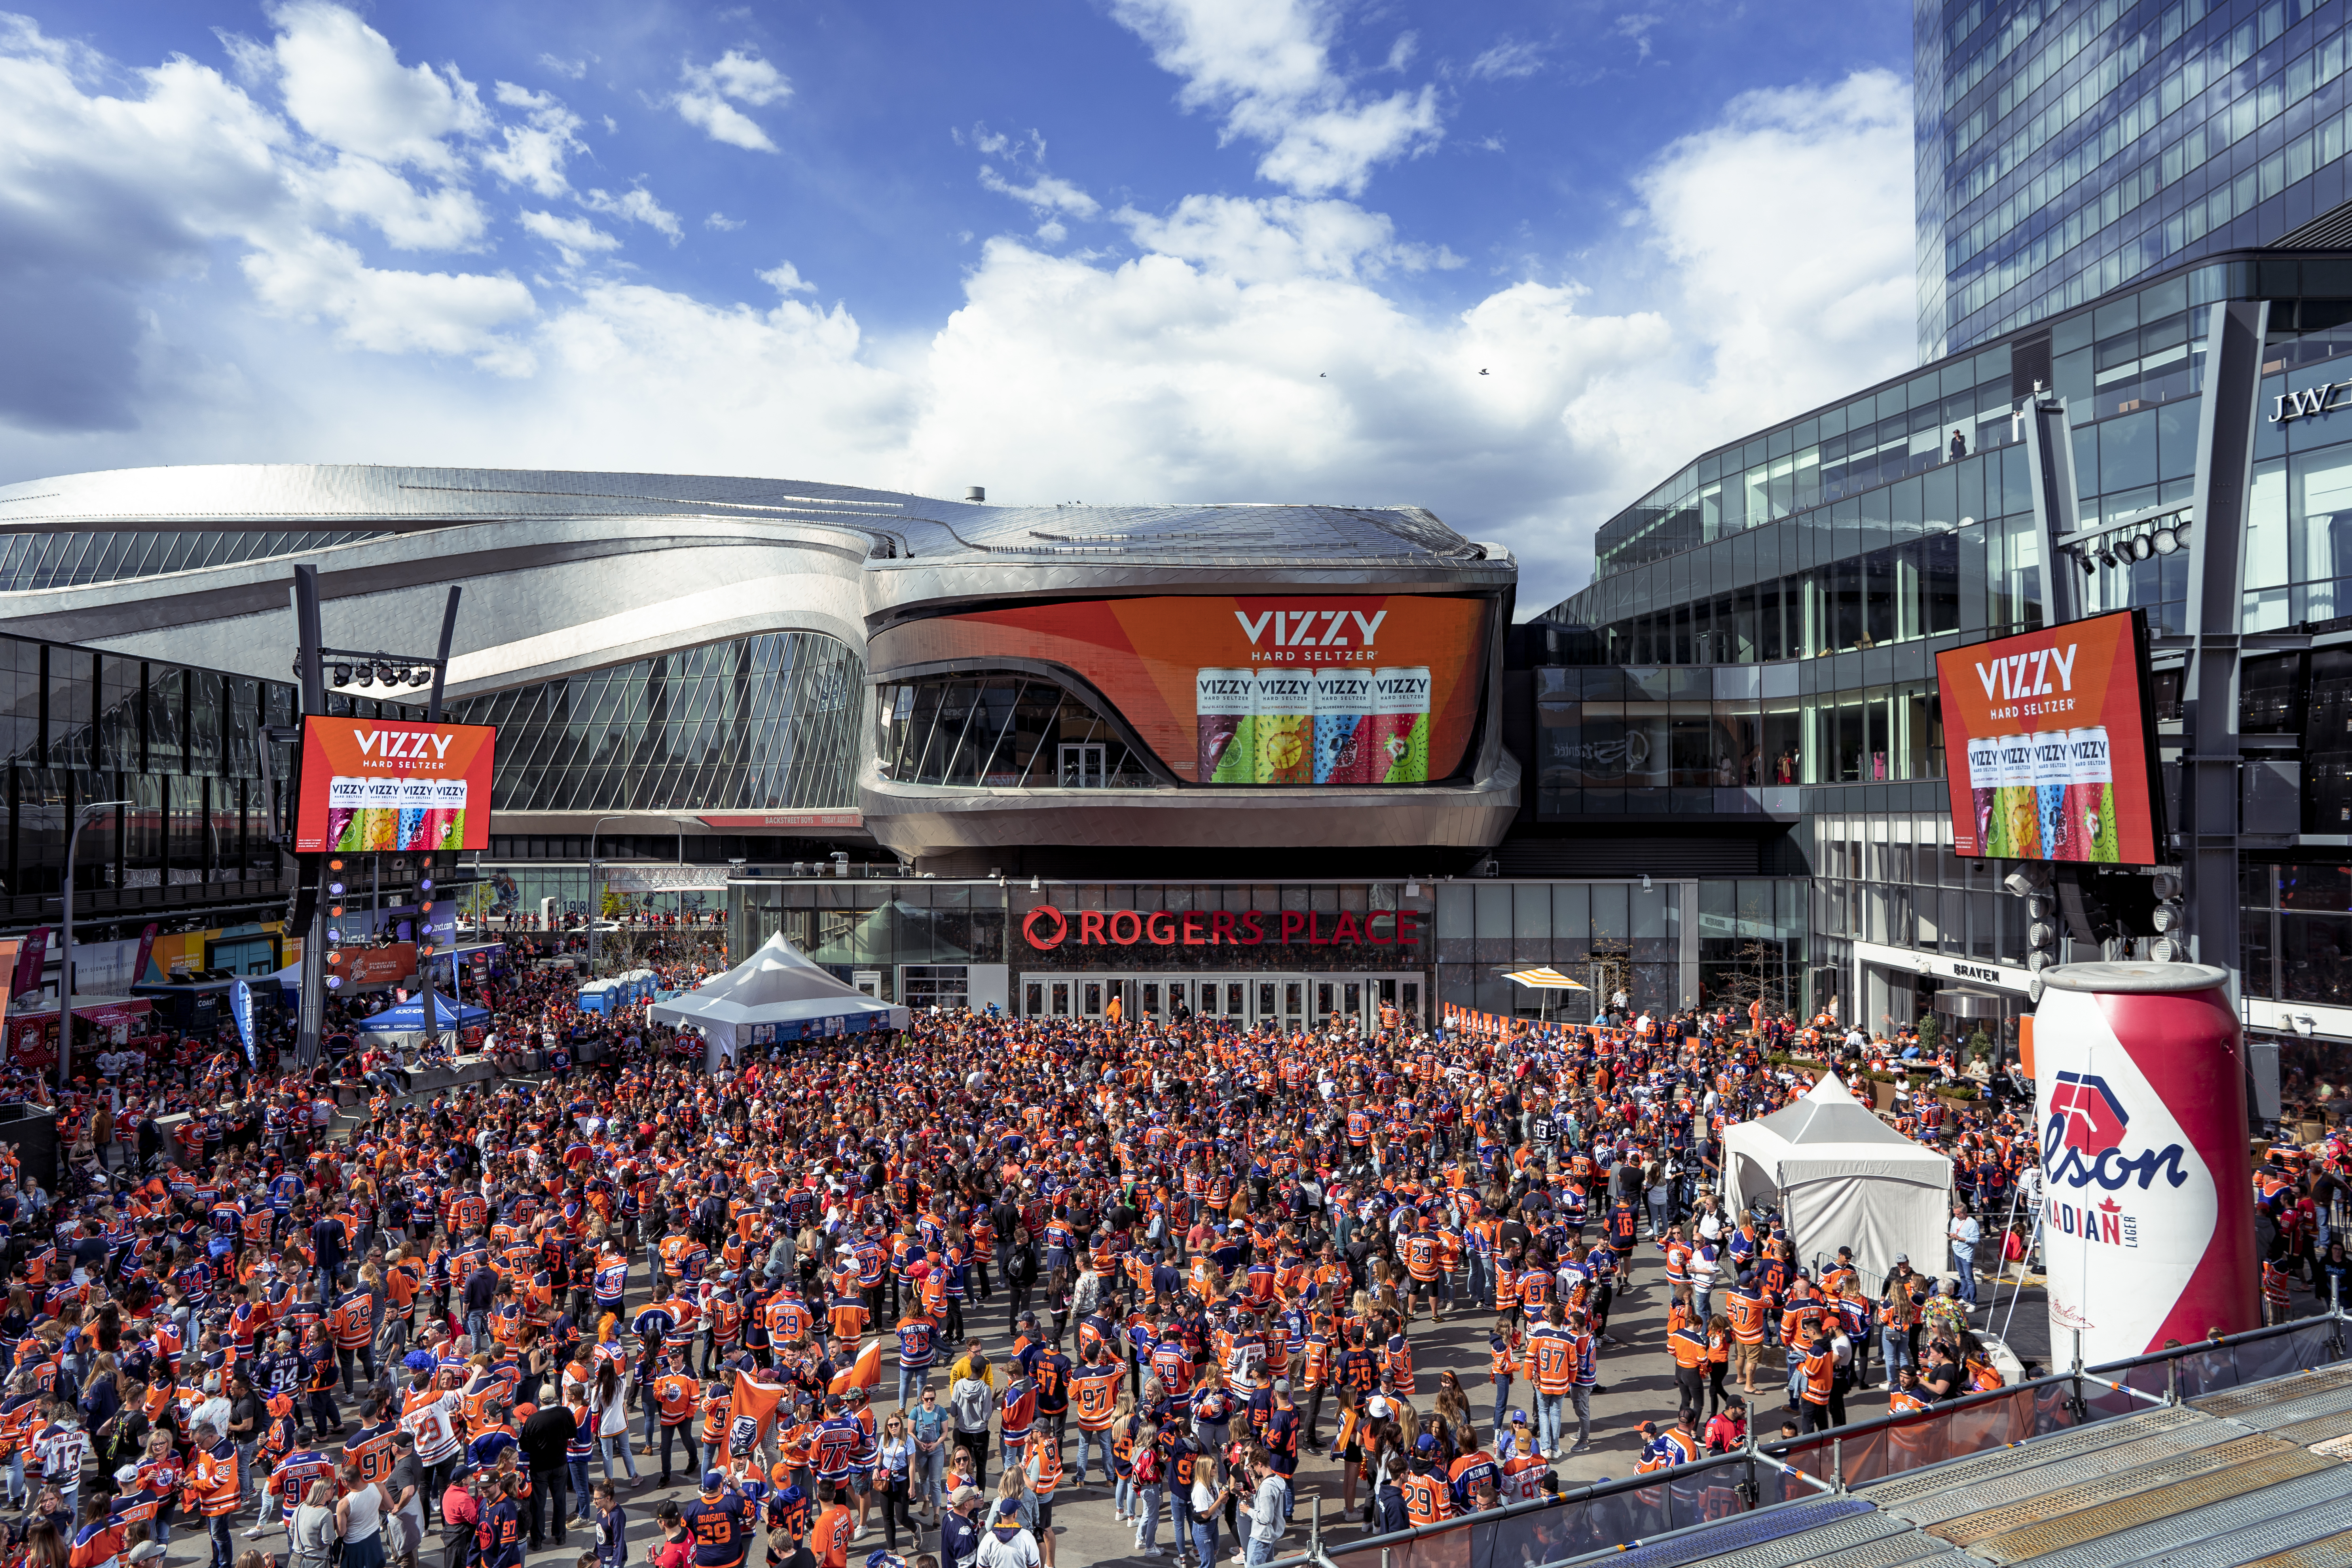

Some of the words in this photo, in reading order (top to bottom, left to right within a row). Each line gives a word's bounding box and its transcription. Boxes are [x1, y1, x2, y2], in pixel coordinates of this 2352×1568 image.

[2269, 383, 2332, 422] JW
[1234, 611, 1387, 646] VIZZY
[1252, 652, 1295, 660] HARD
[1305, 651, 1374, 660] SELTZER
[1975, 644, 2077, 701] VIZZY
[1200, 680, 1251, 694] VIZZY
[1259, 680, 1311, 694] VIZZY
[1318, 680, 1369, 694] VIZZY
[1377, 679, 1427, 693] VIZZY
[1991, 706, 2018, 720] HARD
[2024, 698, 2074, 716] SELTZER
[354, 730, 453, 758] VIZZY
[2071, 741, 2106, 759] VIZZY
[1970, 751, 1997, 766] VIZZY
[2001, 748, 2030, 764] VIZZY
[2034, 745, 2066, 761] VIZZY
[333, 785, 364, 794] VIZZY
[369, 786, 399, 794] VIZZY
[404, 786, 432, 795] VIZZY
[437, 787, 465, 796] VIZZY
[822, 816, 836, 825] FRIDAY,
[563, 900, 589, 914] 198
[1081, 910, 1263, 945] ROGERS
[1282, 910, 1419, 945] PLACE
[283, 943, 302, 952] SUCCES
[90, 963, 119, 972] SIGNATURE
[172, 959, 199, 967] SUCCESS
[26, 956, 36, 987] LEMONADE
[1954, 964, 1999, 983] BRAVEN
[198, 998, 216, 1007] COAST
[2042, 1112, 2188, 1190] lson
[279, 1182, 296, 1197] 14
[791, 1202, 811, 1219] 99
[1618, 1218, 1633, 1236] 18
[2045, 1197, 2120, 1245] NADIAN
[2124, 1216, 2138, 1248] LAGER
[1564, 1271, 1580, 1280] EBERLE
[1772, 1264, 1783, 1272] KANE
[180, 1271, 203, 1292] 94
[1766, 1270, 1784, 1294] 91
[346, 1299, 367, 1310] DRAISAITL
[347, 1306, 370, 1332] 29
[1731, 1304, 1749, 1325] 97
[566, 1326, 578, 1337] 18
[776, 1315, 799, 1335] 29
[903, 1325, 929, 1333] GRETZKY
[905, 1333, 929, 1353] 99
[1267, 1339, 1284, 1358] 97
[1544, 1340, 1564, 1349] McDAVID
[275, 1358, 298, 1368] SMYTH
[1038, 1361, 1054, 1371] McDAVID
[1349, 1359, 1369, 1367] DRAISAITL
[1540, 1348, 1565, 1373] 97
[271, 1369, 300, 1390] 94
[1037, 1370, 1057, 1396] 97
[1156, 1363, 1178, 1388] 29
[1349, 1367, 1371, 1392] 29
[1082, 1386, 1107, 1412] 97
[410, 1408, 433, 1424] DRAISAITL
[1254, 1410, 1267, 1420] 56
[414, 1416, 442, 1445] 29
[824, 1431, 852, 1441] KLEFBOM
[1267, 1428, 1281, 1443] 44
[366, 1437, 389, 1450] McDAVID
[56, 1443, 80, 1473] 13
[362, 1446, 390, 1480] 97
[822, 1443, 852, 1469] 77
[217, 1466, 231, 1475] 29
[288, 1465, 317, 1477] McDAVID
[1468, 1466, 1489, 1479] McDAVID
[1406, 1475, 1429, 1486] RAISAITL
[1404, 1483, 1432, 1517] 29
[1710, 1498, 1733, 1519] 97
[698, 1514, 727, 1522] DRAISAITL
[785, 1509, 805, 1540] 13
[503, 1521, 516, 1536] 97
[696, 1521, 731, 1545] 29
